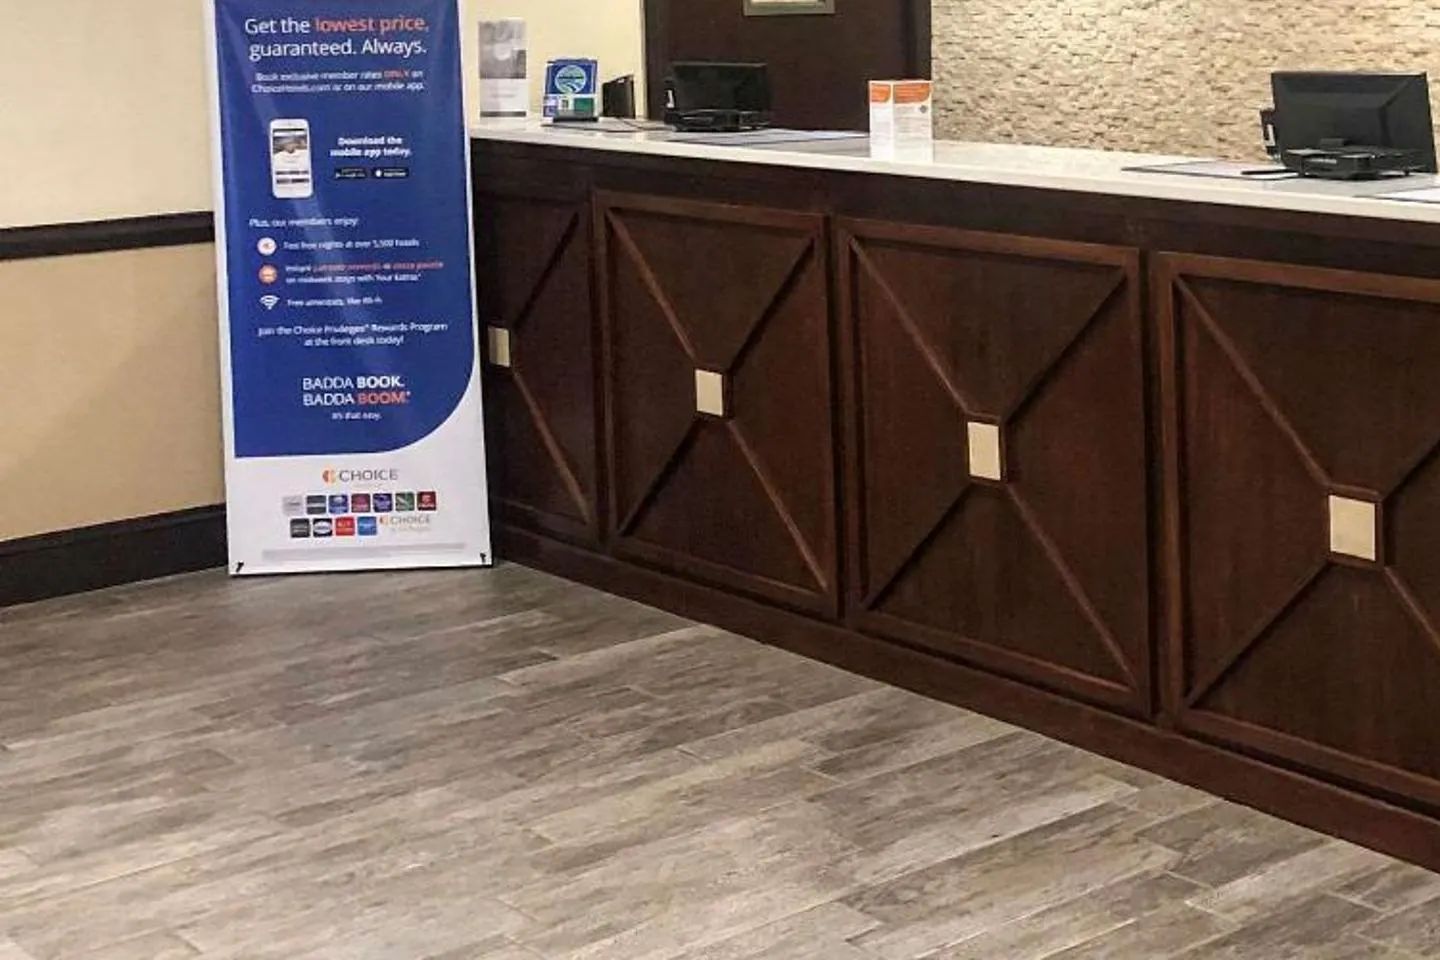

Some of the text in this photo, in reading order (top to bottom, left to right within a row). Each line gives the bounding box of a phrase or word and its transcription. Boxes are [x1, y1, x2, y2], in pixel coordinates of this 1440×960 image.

[245, 18, 278, 34] Get
[281, 17, 310, 33] the
[315, 17, 375, 33] lowest
[249, 38, 427, 62] guaranteed. Always.
[338, 135, 403, 145] Download the
[364, 149, 381, 158] app
[303, 375, 405, 391] BADDA BOOK.
[303, 392, 355, 406] BADDA
[339, 468, 399, 482] CHOICE
[390, 515, 431, 525] CHOICE
